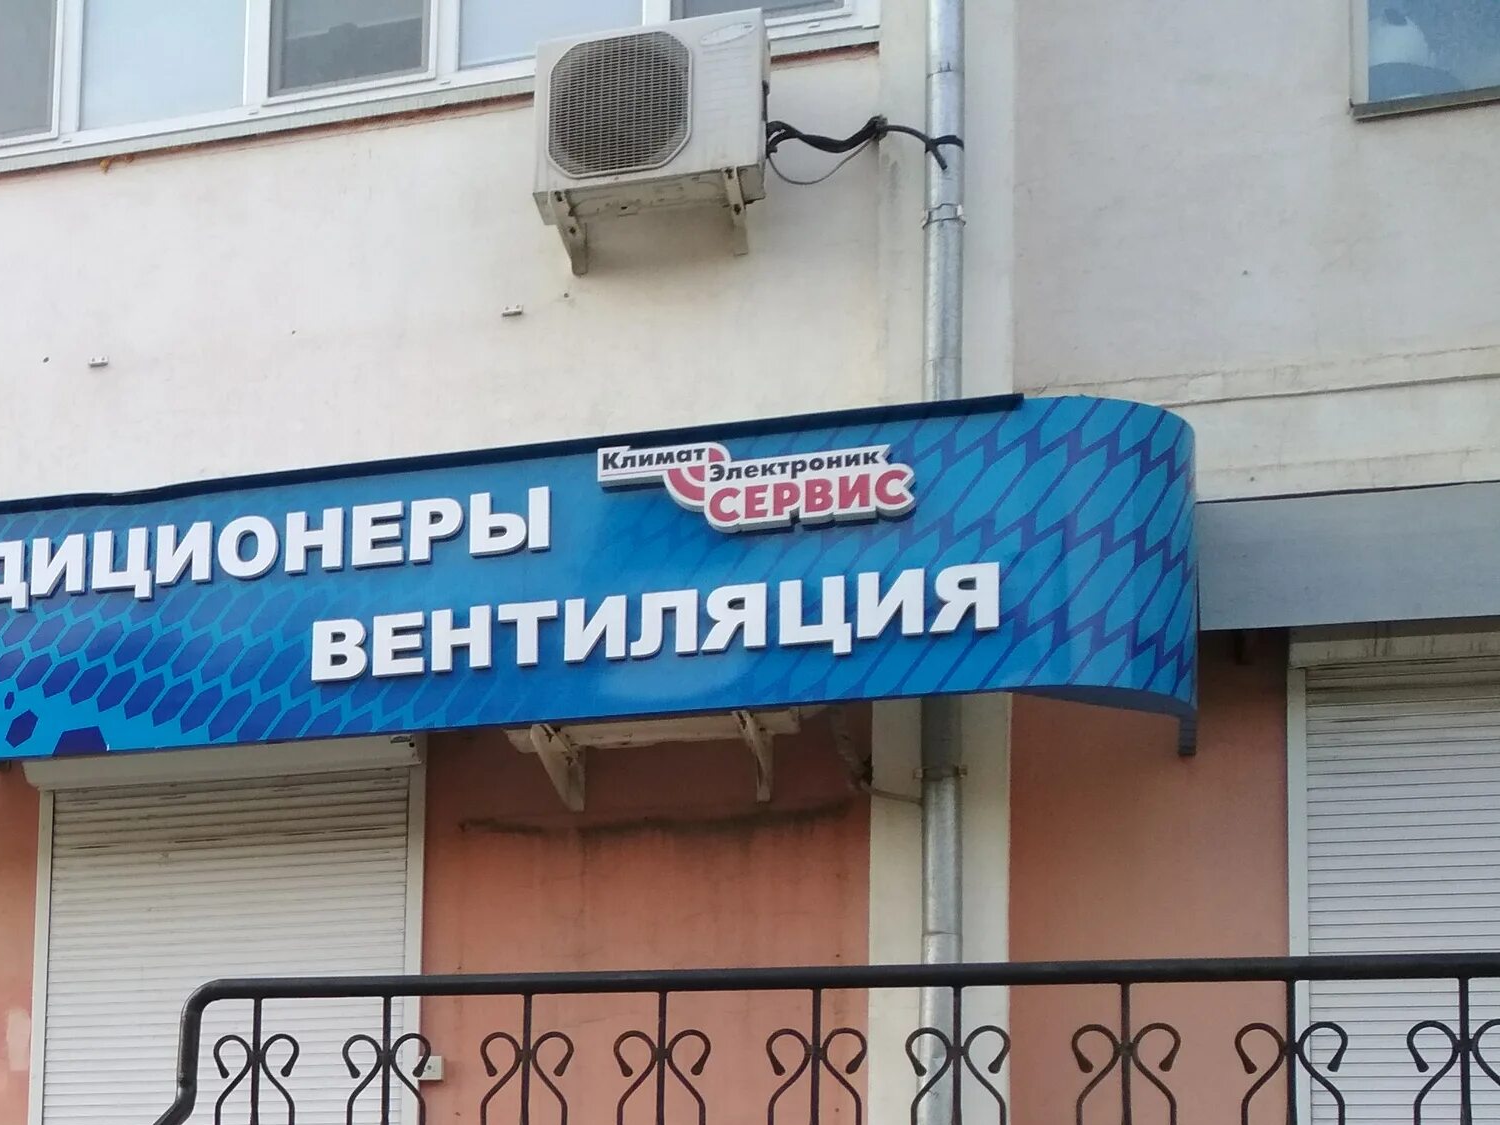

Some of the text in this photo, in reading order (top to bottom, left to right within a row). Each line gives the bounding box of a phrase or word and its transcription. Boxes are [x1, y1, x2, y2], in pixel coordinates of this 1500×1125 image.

[601, 447, 705, 470] Климат
[708, 451, 880, 482] Электроник
[709, 470, 912, 522] СЕРВИС
[310, 562, 1000, 684] ВЕНТИЛЯЦИЯ
